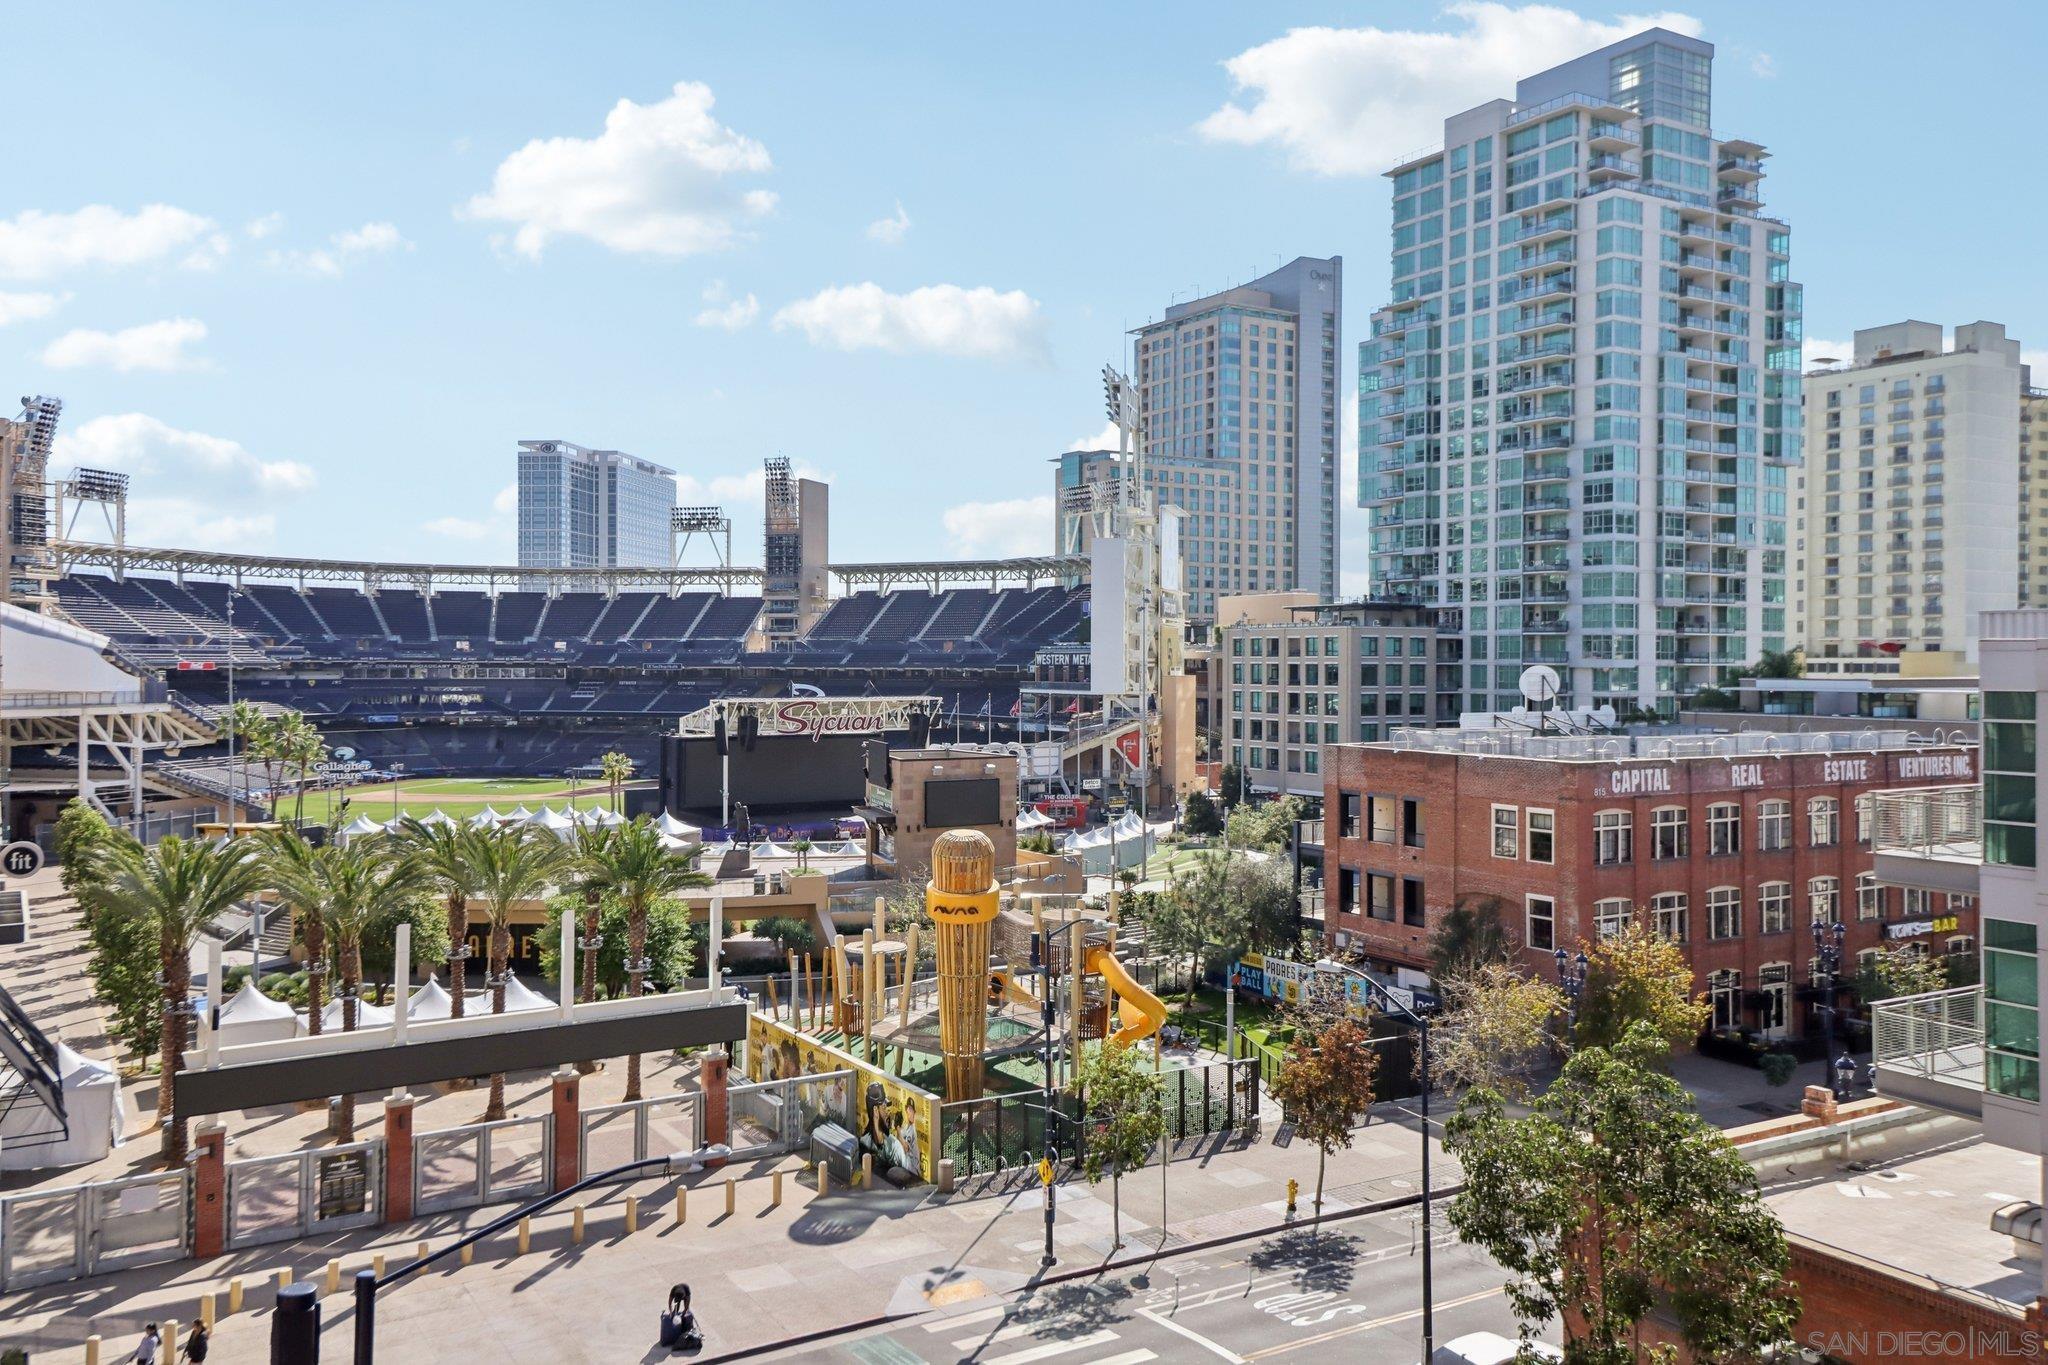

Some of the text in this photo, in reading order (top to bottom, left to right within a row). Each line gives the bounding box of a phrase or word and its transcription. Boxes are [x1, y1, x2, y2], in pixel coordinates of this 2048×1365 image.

[1036, 653, 1070, 666] WESTERN
[777, 700, 885, 743] Sycuan
[313, 760, 371, 773] Gallagher
[320, 771, 362, 783] Square
[1593, 755, 1974, 798] 815 CAPITAL REAL ESTATE VENTURES INC.
[10, 851, 32, 870] fit
[1933, 917, 1958, 933] BAR
[1241, 966, 1262, 980] PLAY
[1265, 960, 1296, 980] PADRES
[1241, 977, 1262, 990] BALL
